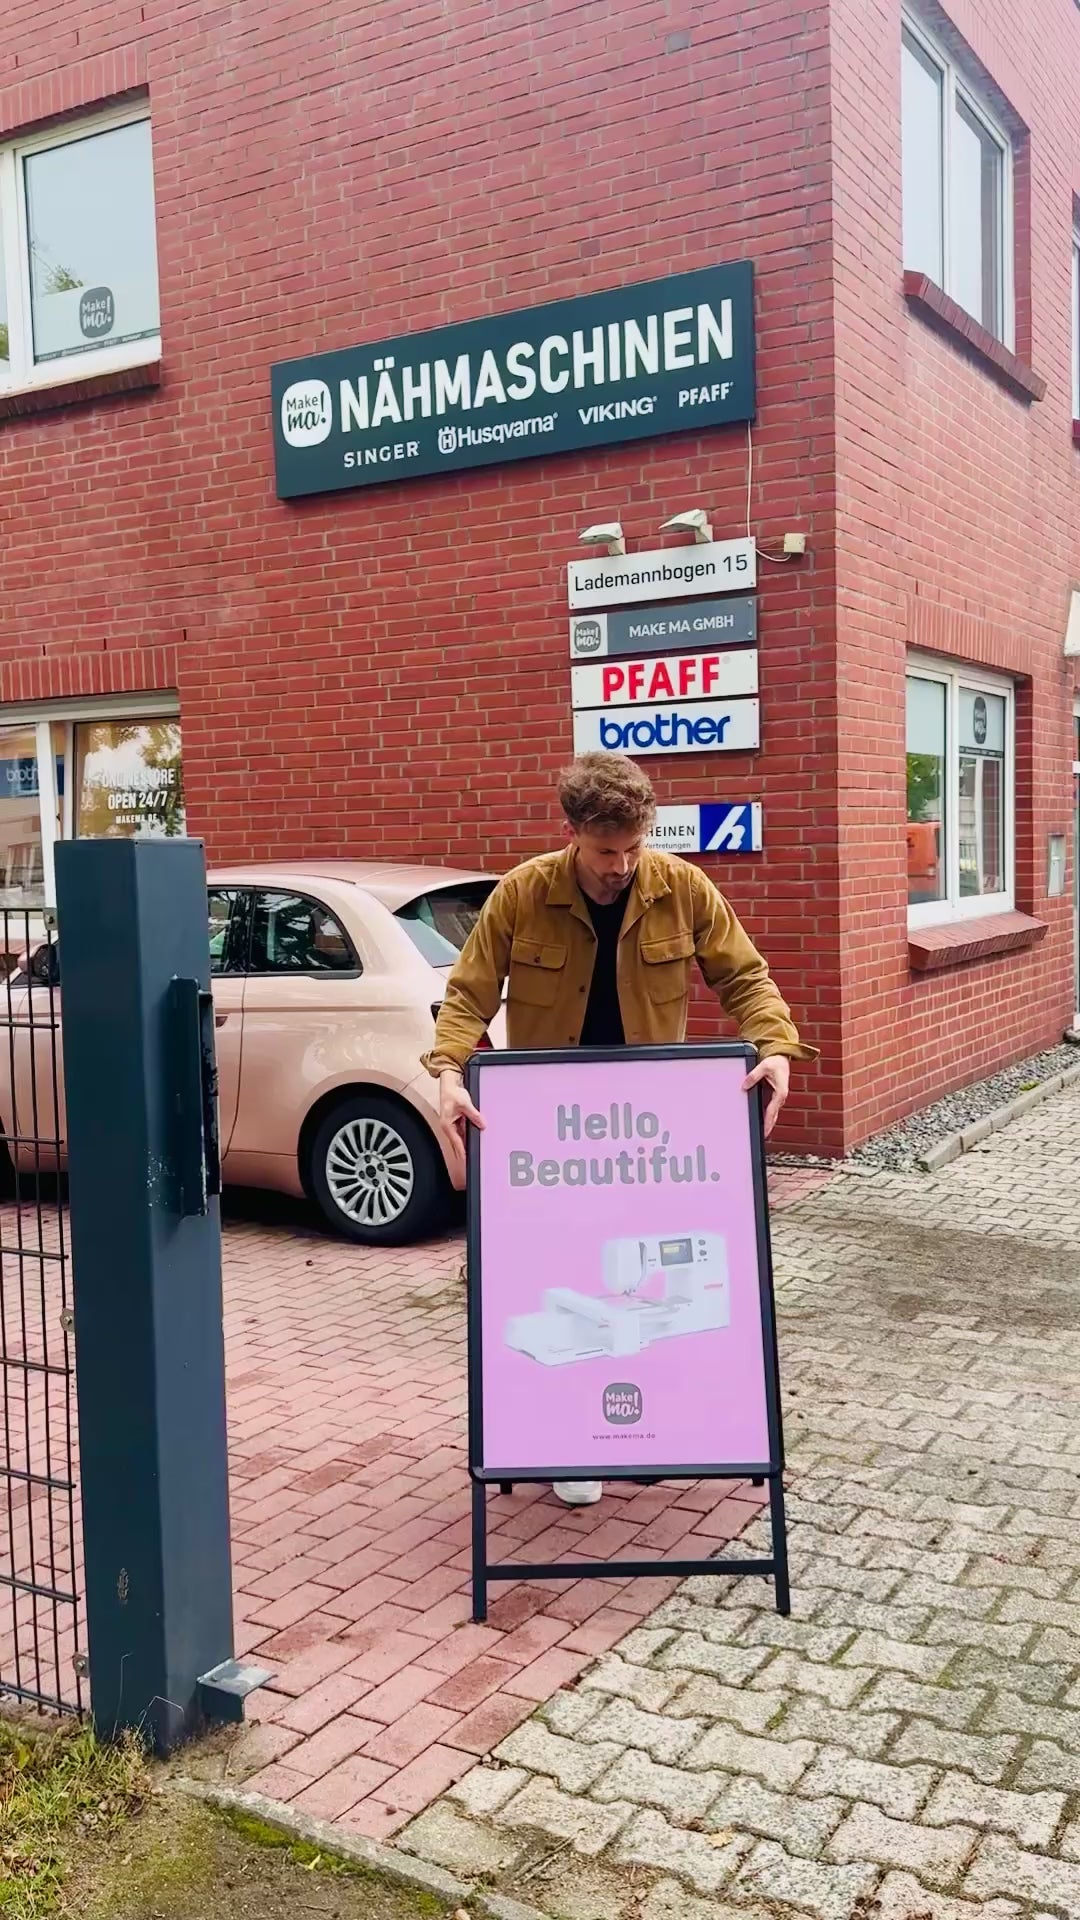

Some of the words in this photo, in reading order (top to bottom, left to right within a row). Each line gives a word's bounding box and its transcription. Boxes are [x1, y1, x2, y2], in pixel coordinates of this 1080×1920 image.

[82, 299, 106, 314] Make
[339, 298, 733, 433] NÄHMASCHINEN
[286, 395, 319, 412] Make
[287, 390, 327, 433] ma!
[343, 441, 420, 468] SINGER
[457, 412, 557, 448] Husqvarna
[578, 396, 655, 425] VIKING
[678, 382, 731, 408] PFAFF
[575, 561, 716, 592] Lademannbogen
[722, 553, 748, 573] 15
[575, 627, 595, 638] Make
[628, 621, 667, 638] MAKE
[668, 620, 691, 634] MA
[692, 614, 734, 632] GMBH
[602, 656, 720, 702] PFAFF
[600, 712, 731, 750] brother
[107, 791, 137, 810] OPEN
[138, 790, 168, 809] 24/7
[557, 1102, 670, 1145] Hello,
[509, 1144, 721, 1187] Beautiful.
[605, 1391, 634, 1403] Make
